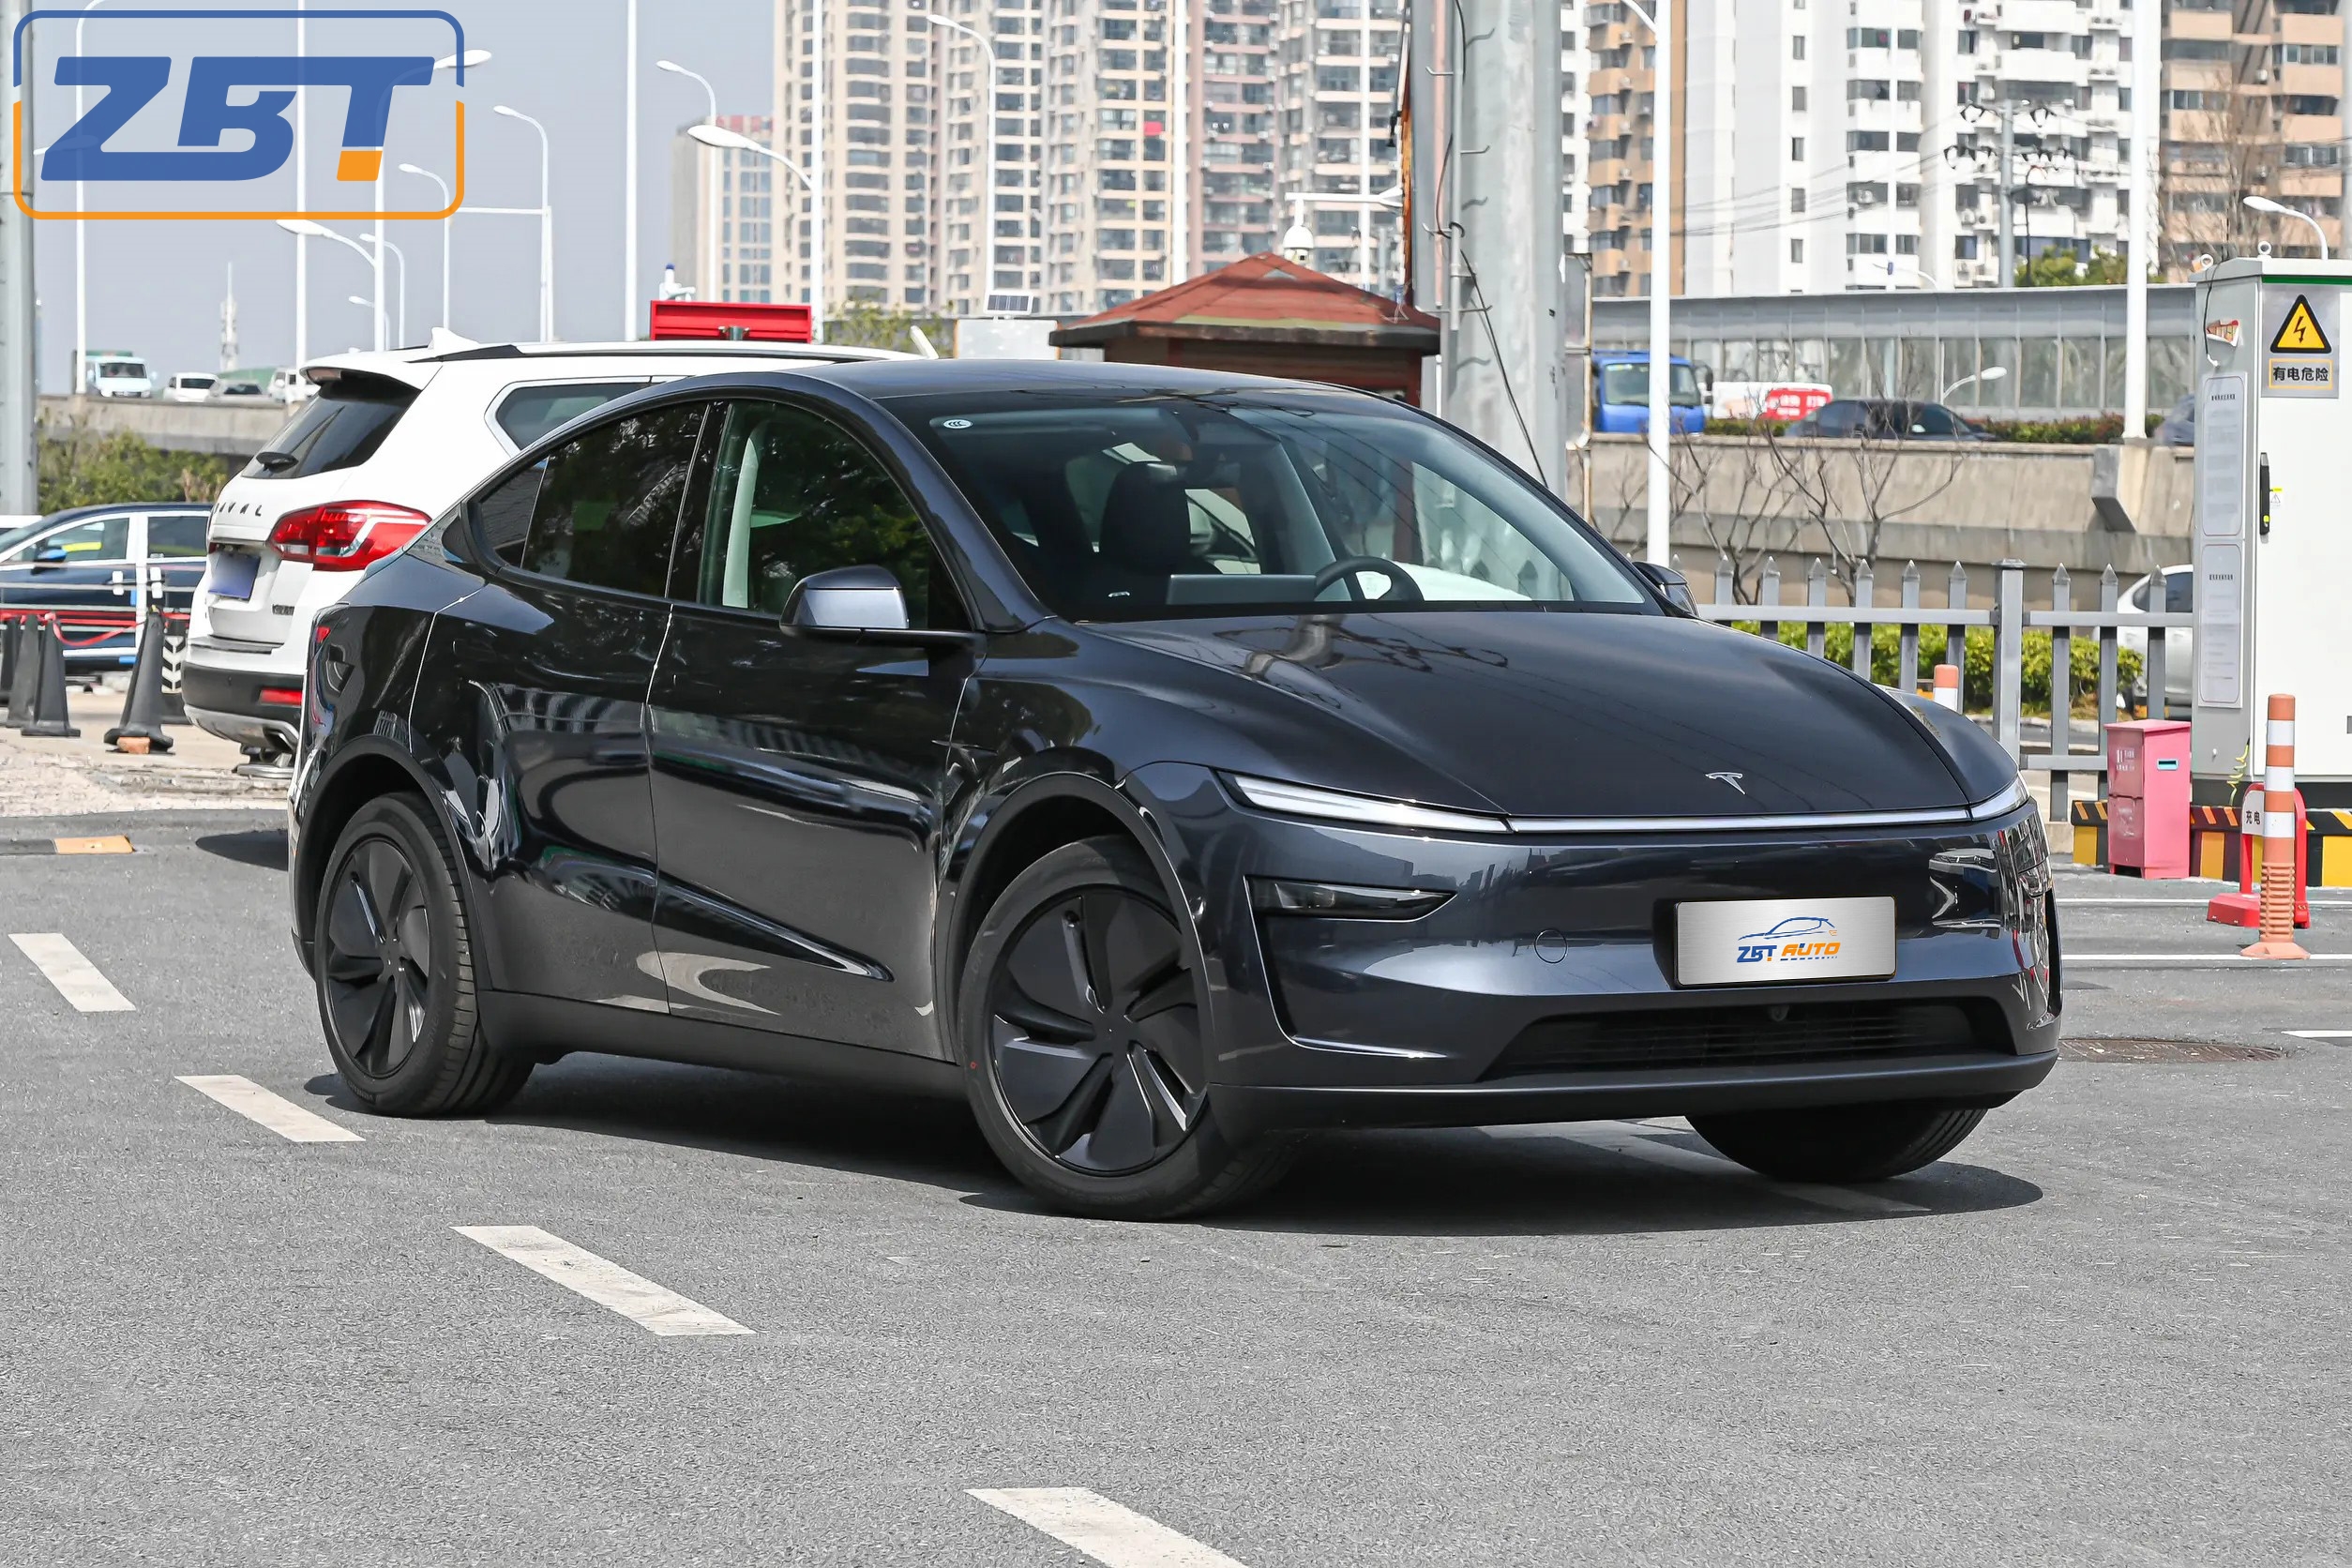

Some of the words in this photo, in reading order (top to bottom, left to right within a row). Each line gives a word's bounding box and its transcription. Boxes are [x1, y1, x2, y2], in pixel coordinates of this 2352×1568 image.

[2272, 366, 2329, 382] 有电危险
[2246, 809, 2261, 825] 充电
[1737, 944, 1778, 962] ZBT
[1781, 942, 1841, 957] AUTO
